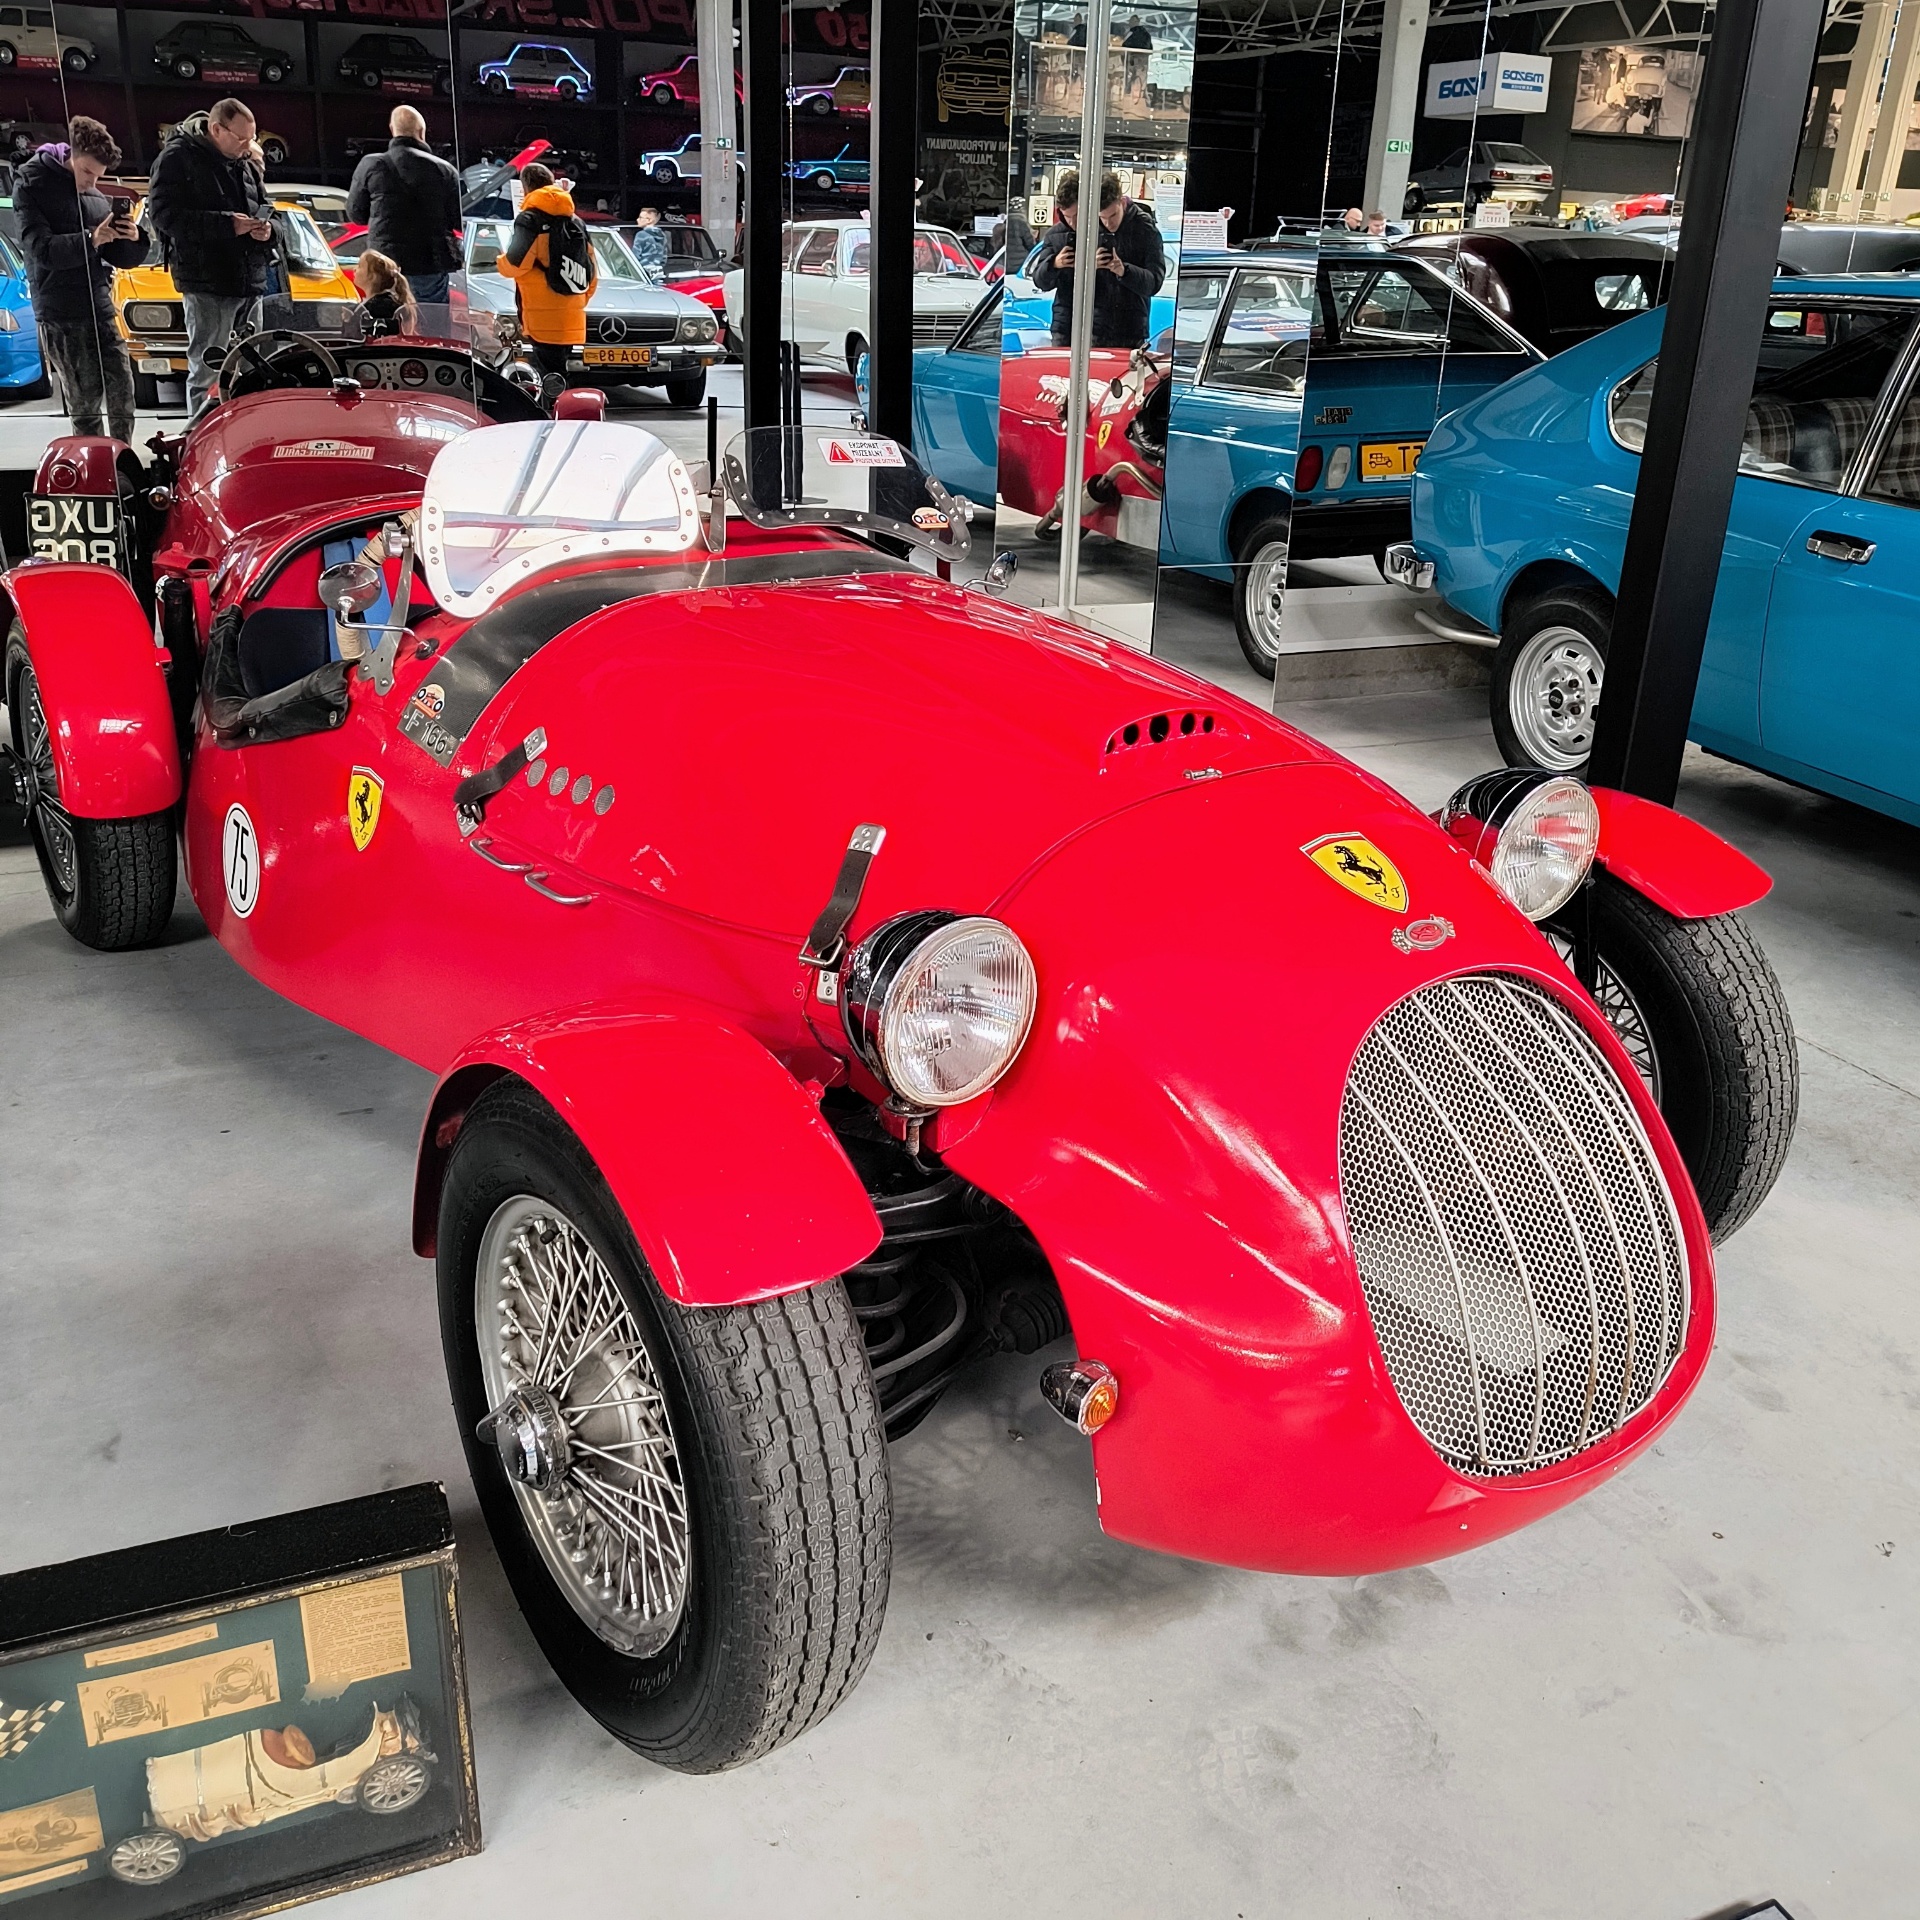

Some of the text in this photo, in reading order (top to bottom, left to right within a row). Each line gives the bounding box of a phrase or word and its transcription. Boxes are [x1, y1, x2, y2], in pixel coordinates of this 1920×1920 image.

[405, 708, 448, 756] F 166
[230, 818, 249, 901] 75
